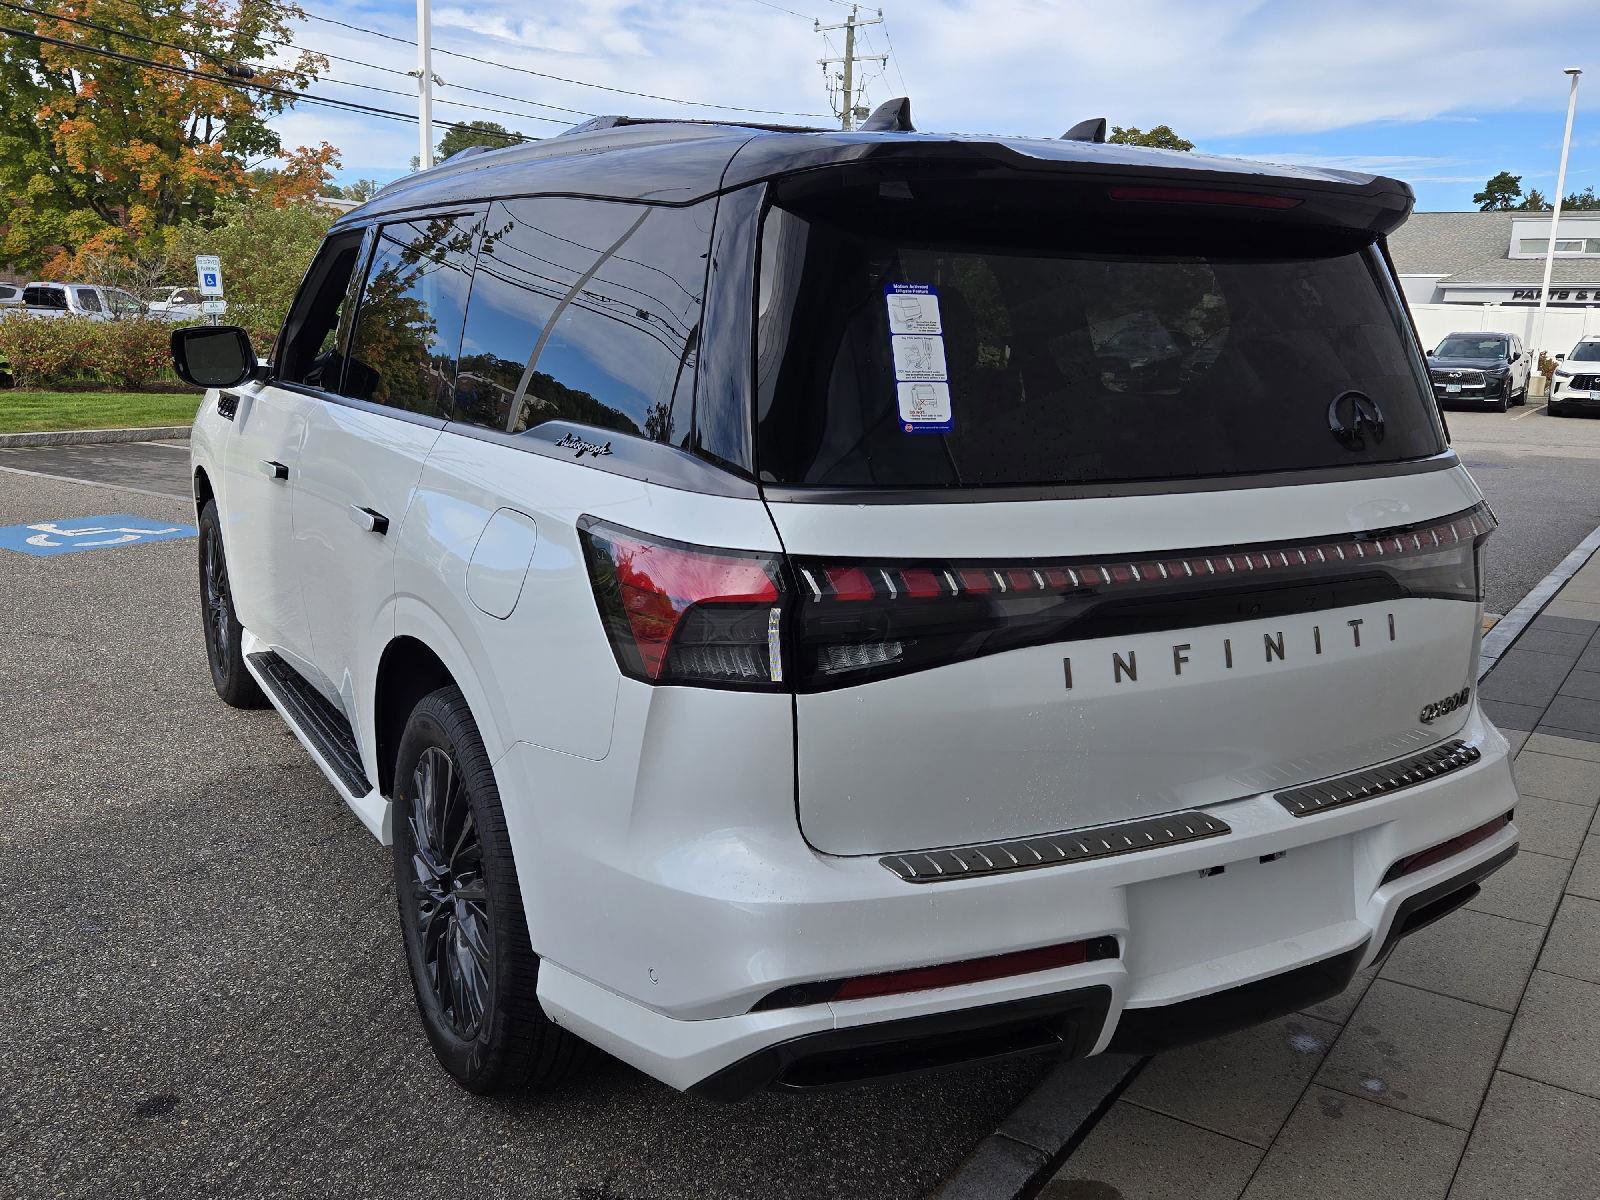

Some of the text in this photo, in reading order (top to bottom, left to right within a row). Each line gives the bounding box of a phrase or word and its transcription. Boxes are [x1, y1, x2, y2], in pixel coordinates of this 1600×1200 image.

[1575, 290, 1589, 300] &
[555, 432, 613, 458] Autograph
[1063, 613, 1396, 689] INFINITI
